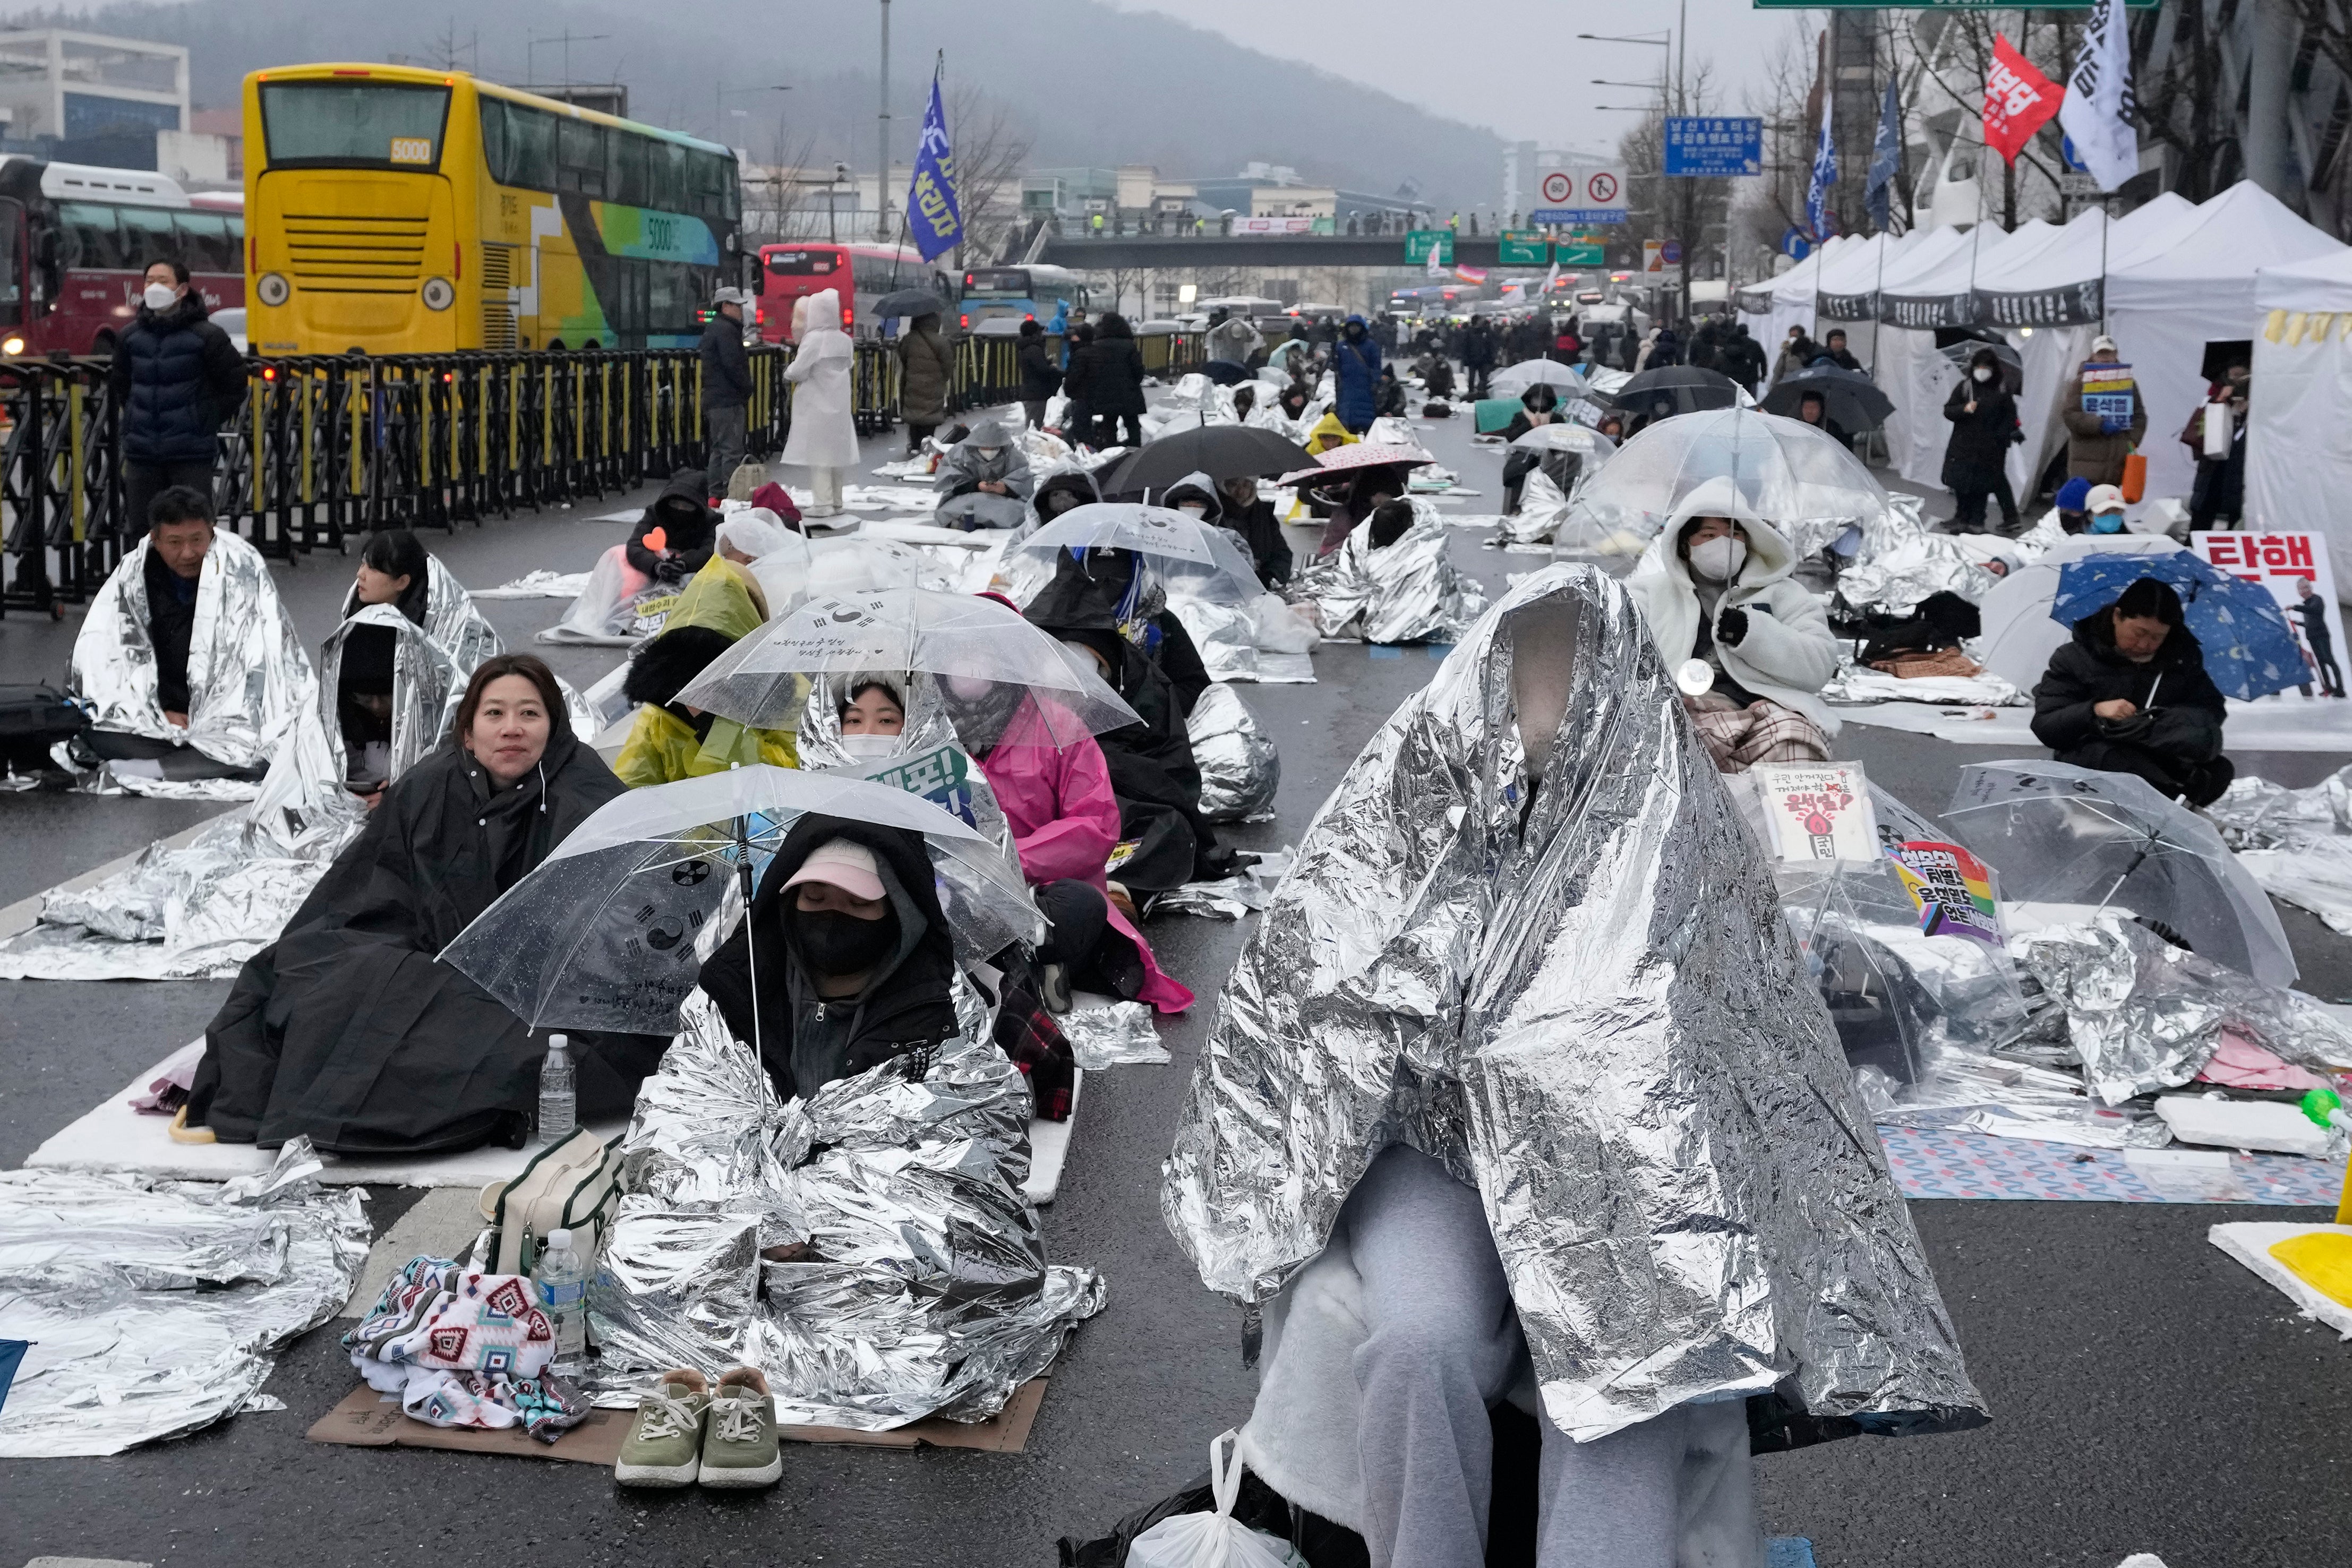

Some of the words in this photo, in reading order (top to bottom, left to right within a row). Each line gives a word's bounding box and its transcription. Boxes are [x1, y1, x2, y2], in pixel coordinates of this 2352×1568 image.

[394, 141, 430, 160] 5000
[648, 217, 671, 251] 5000
[2086, 398, 2127, 412] 윤석열
[2206, 536, 2316, 581] 탄핵
[1772, 773, 1791, 784] 우린
[1817, 837, 1833, 858] 국민
[1943, 904, 1971, 926] 없는
